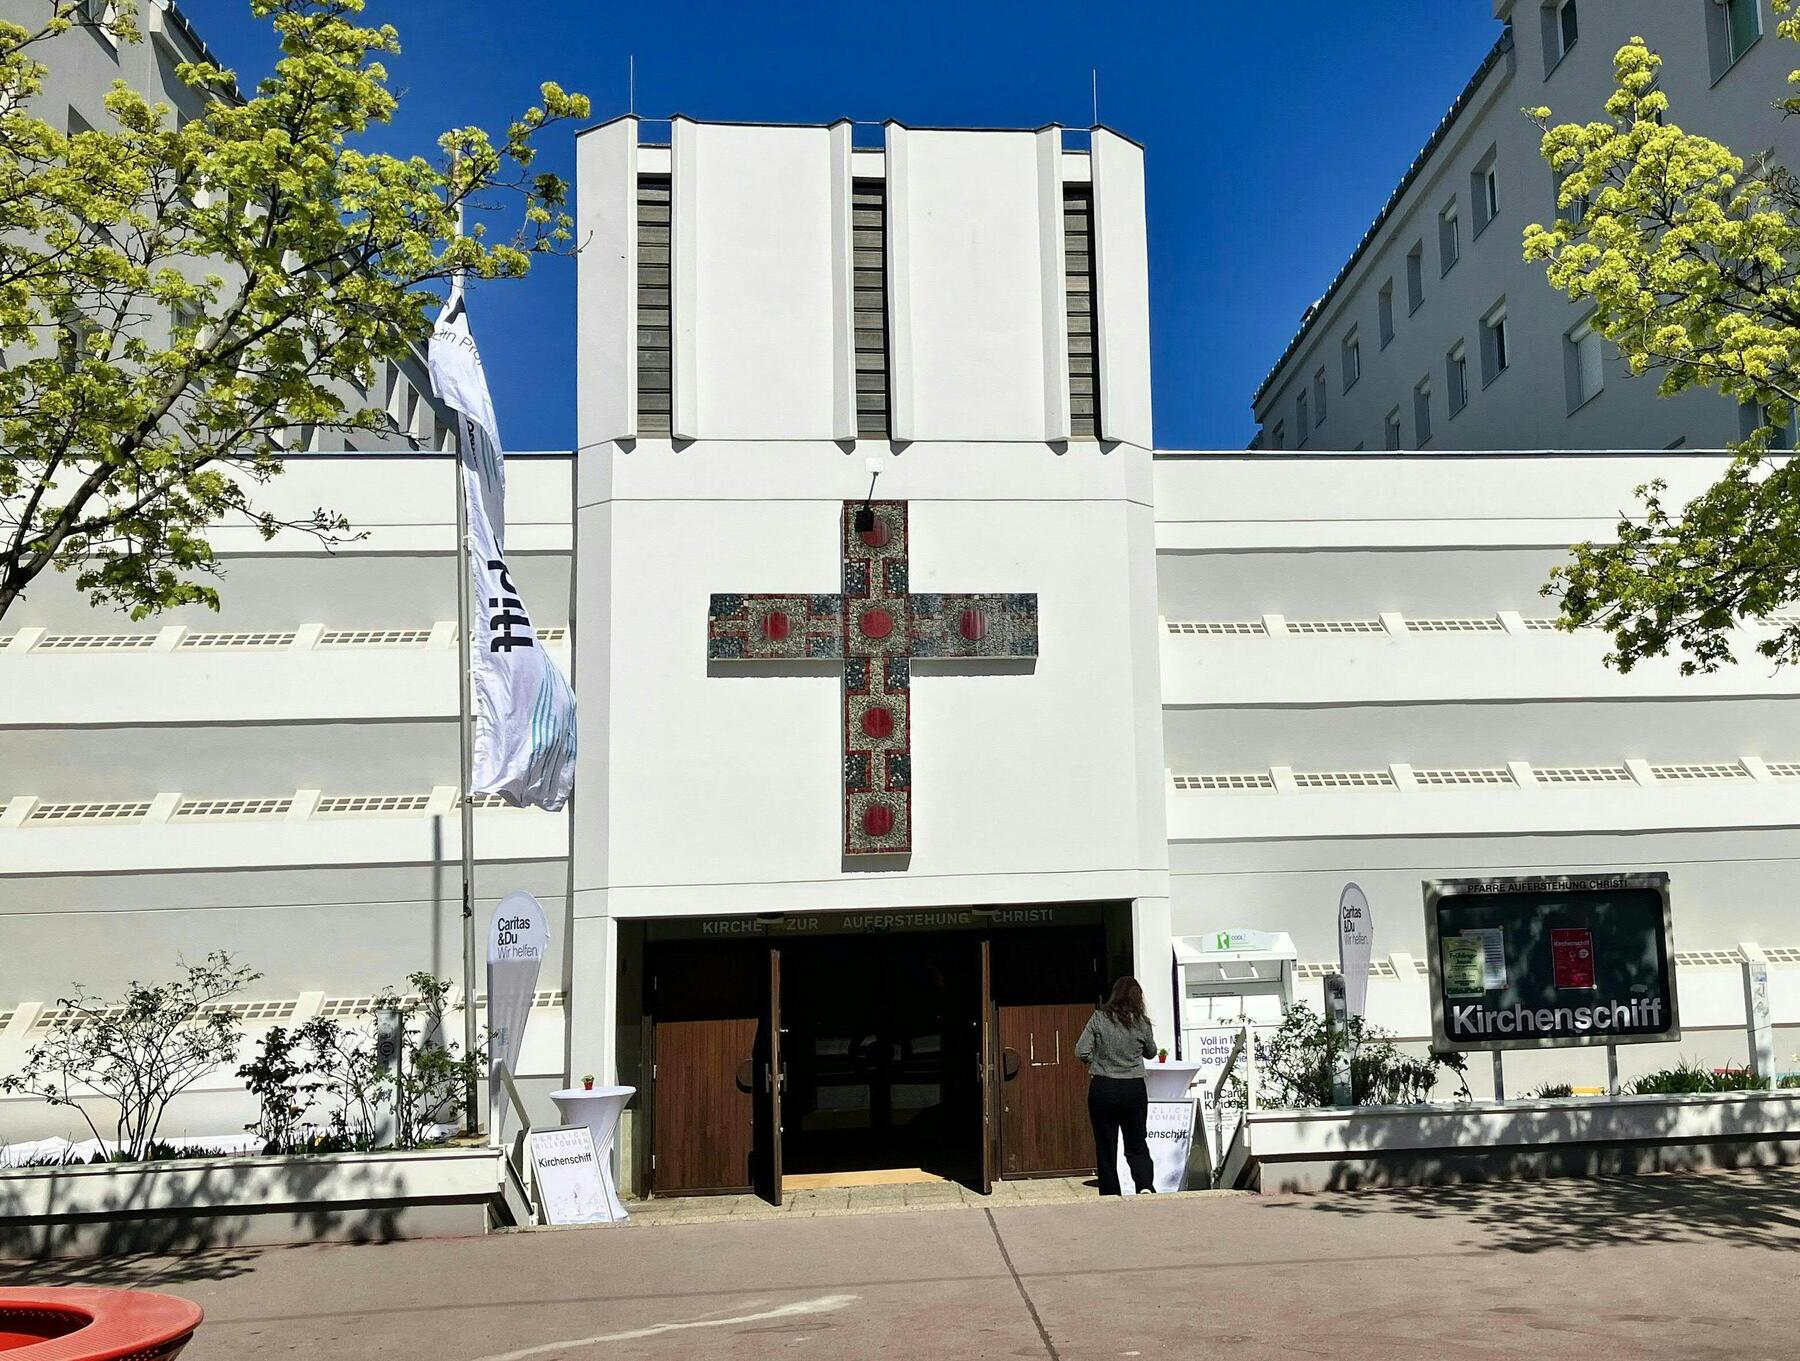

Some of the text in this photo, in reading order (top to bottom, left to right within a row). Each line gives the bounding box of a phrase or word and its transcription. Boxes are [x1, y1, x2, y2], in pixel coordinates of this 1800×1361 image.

[1467, 879, 1628, 893] PFARRE AUFERSTEHUNG CHRISTI
[1343, 905, 1361, 919] Caritas
[498, 916, 530, 931] Caritas
[703, 908, 1053, 934] KIRCHE ZUR AUFERSTEHUNG CHRISTI
[1344, 919, 1355, 933] &Du
[498, 931, 518, 946] &Du
[1344, 934, 1352, 946] Wir
[498, 946, 511, 959] Wir
[1453, 998, 1661, 1034] Kirchenschiff
[1200, 1036, 1218, 1046] Voll
[1219, 1036, 1228, 1045] in
[1201, 1046, 1230, 1055] nichts
[538, 1152, 592, 1167] Kirchenschiff
